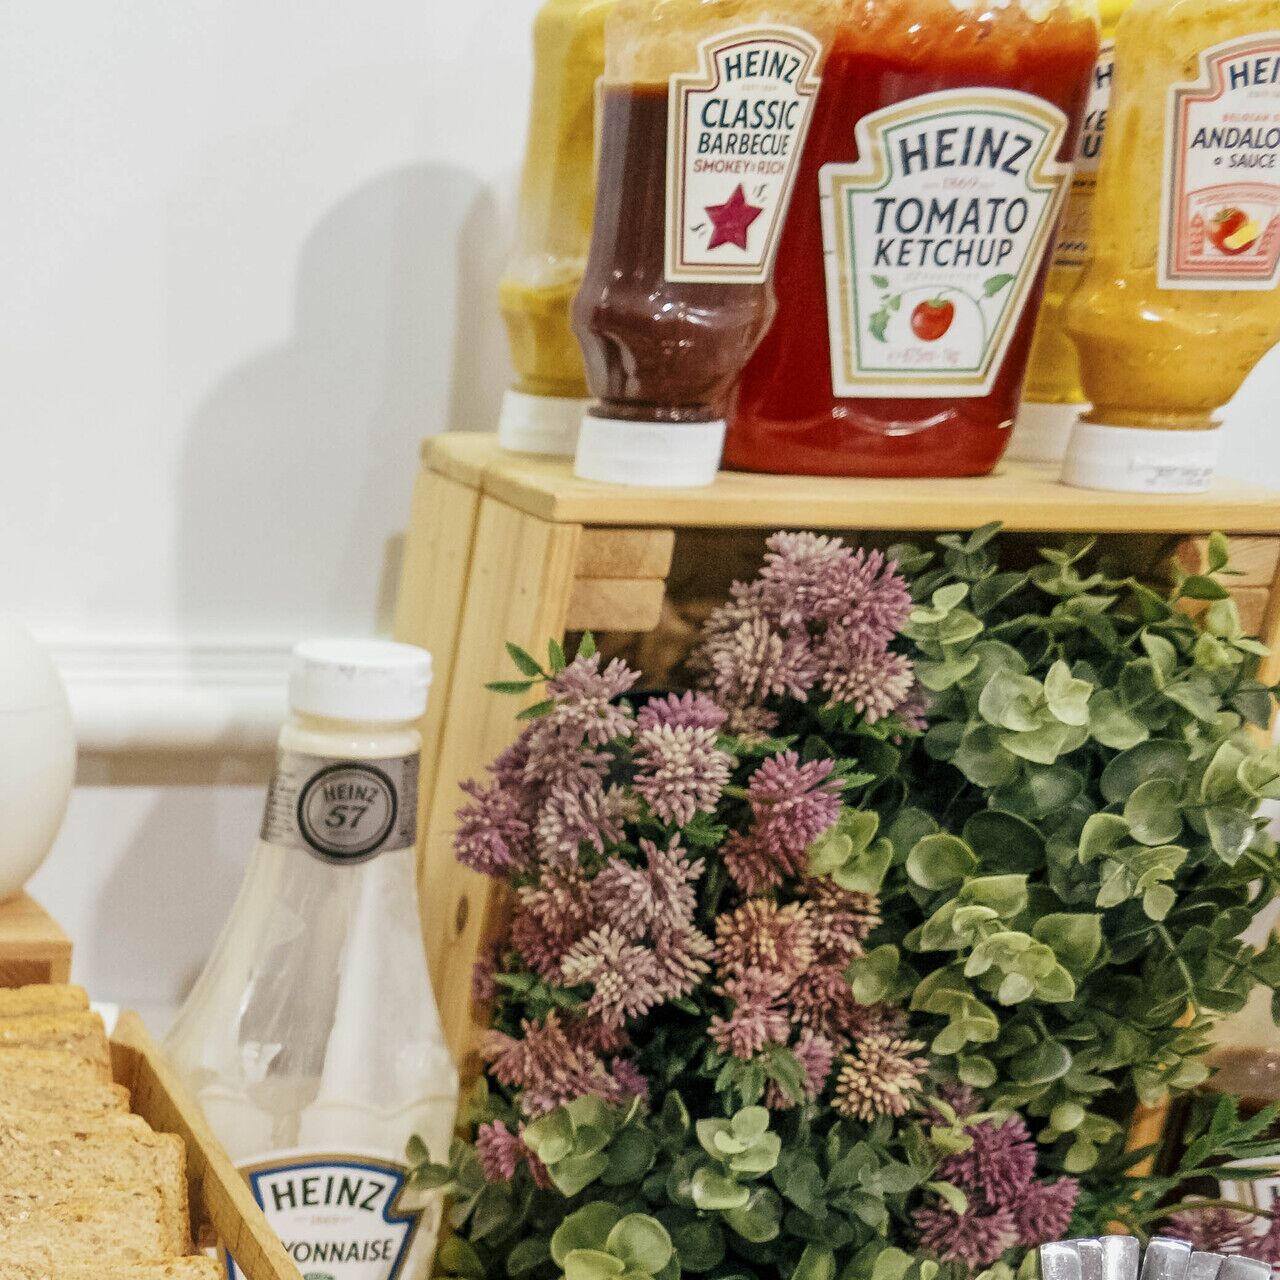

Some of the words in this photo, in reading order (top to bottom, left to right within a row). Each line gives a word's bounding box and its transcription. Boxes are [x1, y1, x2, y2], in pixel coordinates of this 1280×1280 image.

[725, 50, 801, 83] HEINZ
[701, 98, 799, 129] CLASSIC
[697, 132, 790, 155] BARBECUE
[899, 126, 1033, 176] HEINZ
[1228, 153, 1275, 168] SAUCE
[873, 196, 1029, 234] TOMATO
[873, 238, 1013, 268] KETCHUP
[322, 784, 379, 804] HEINZ
[325, 805, 368, 829] 57
[270, 1176, 386, 1212] HEINZ
